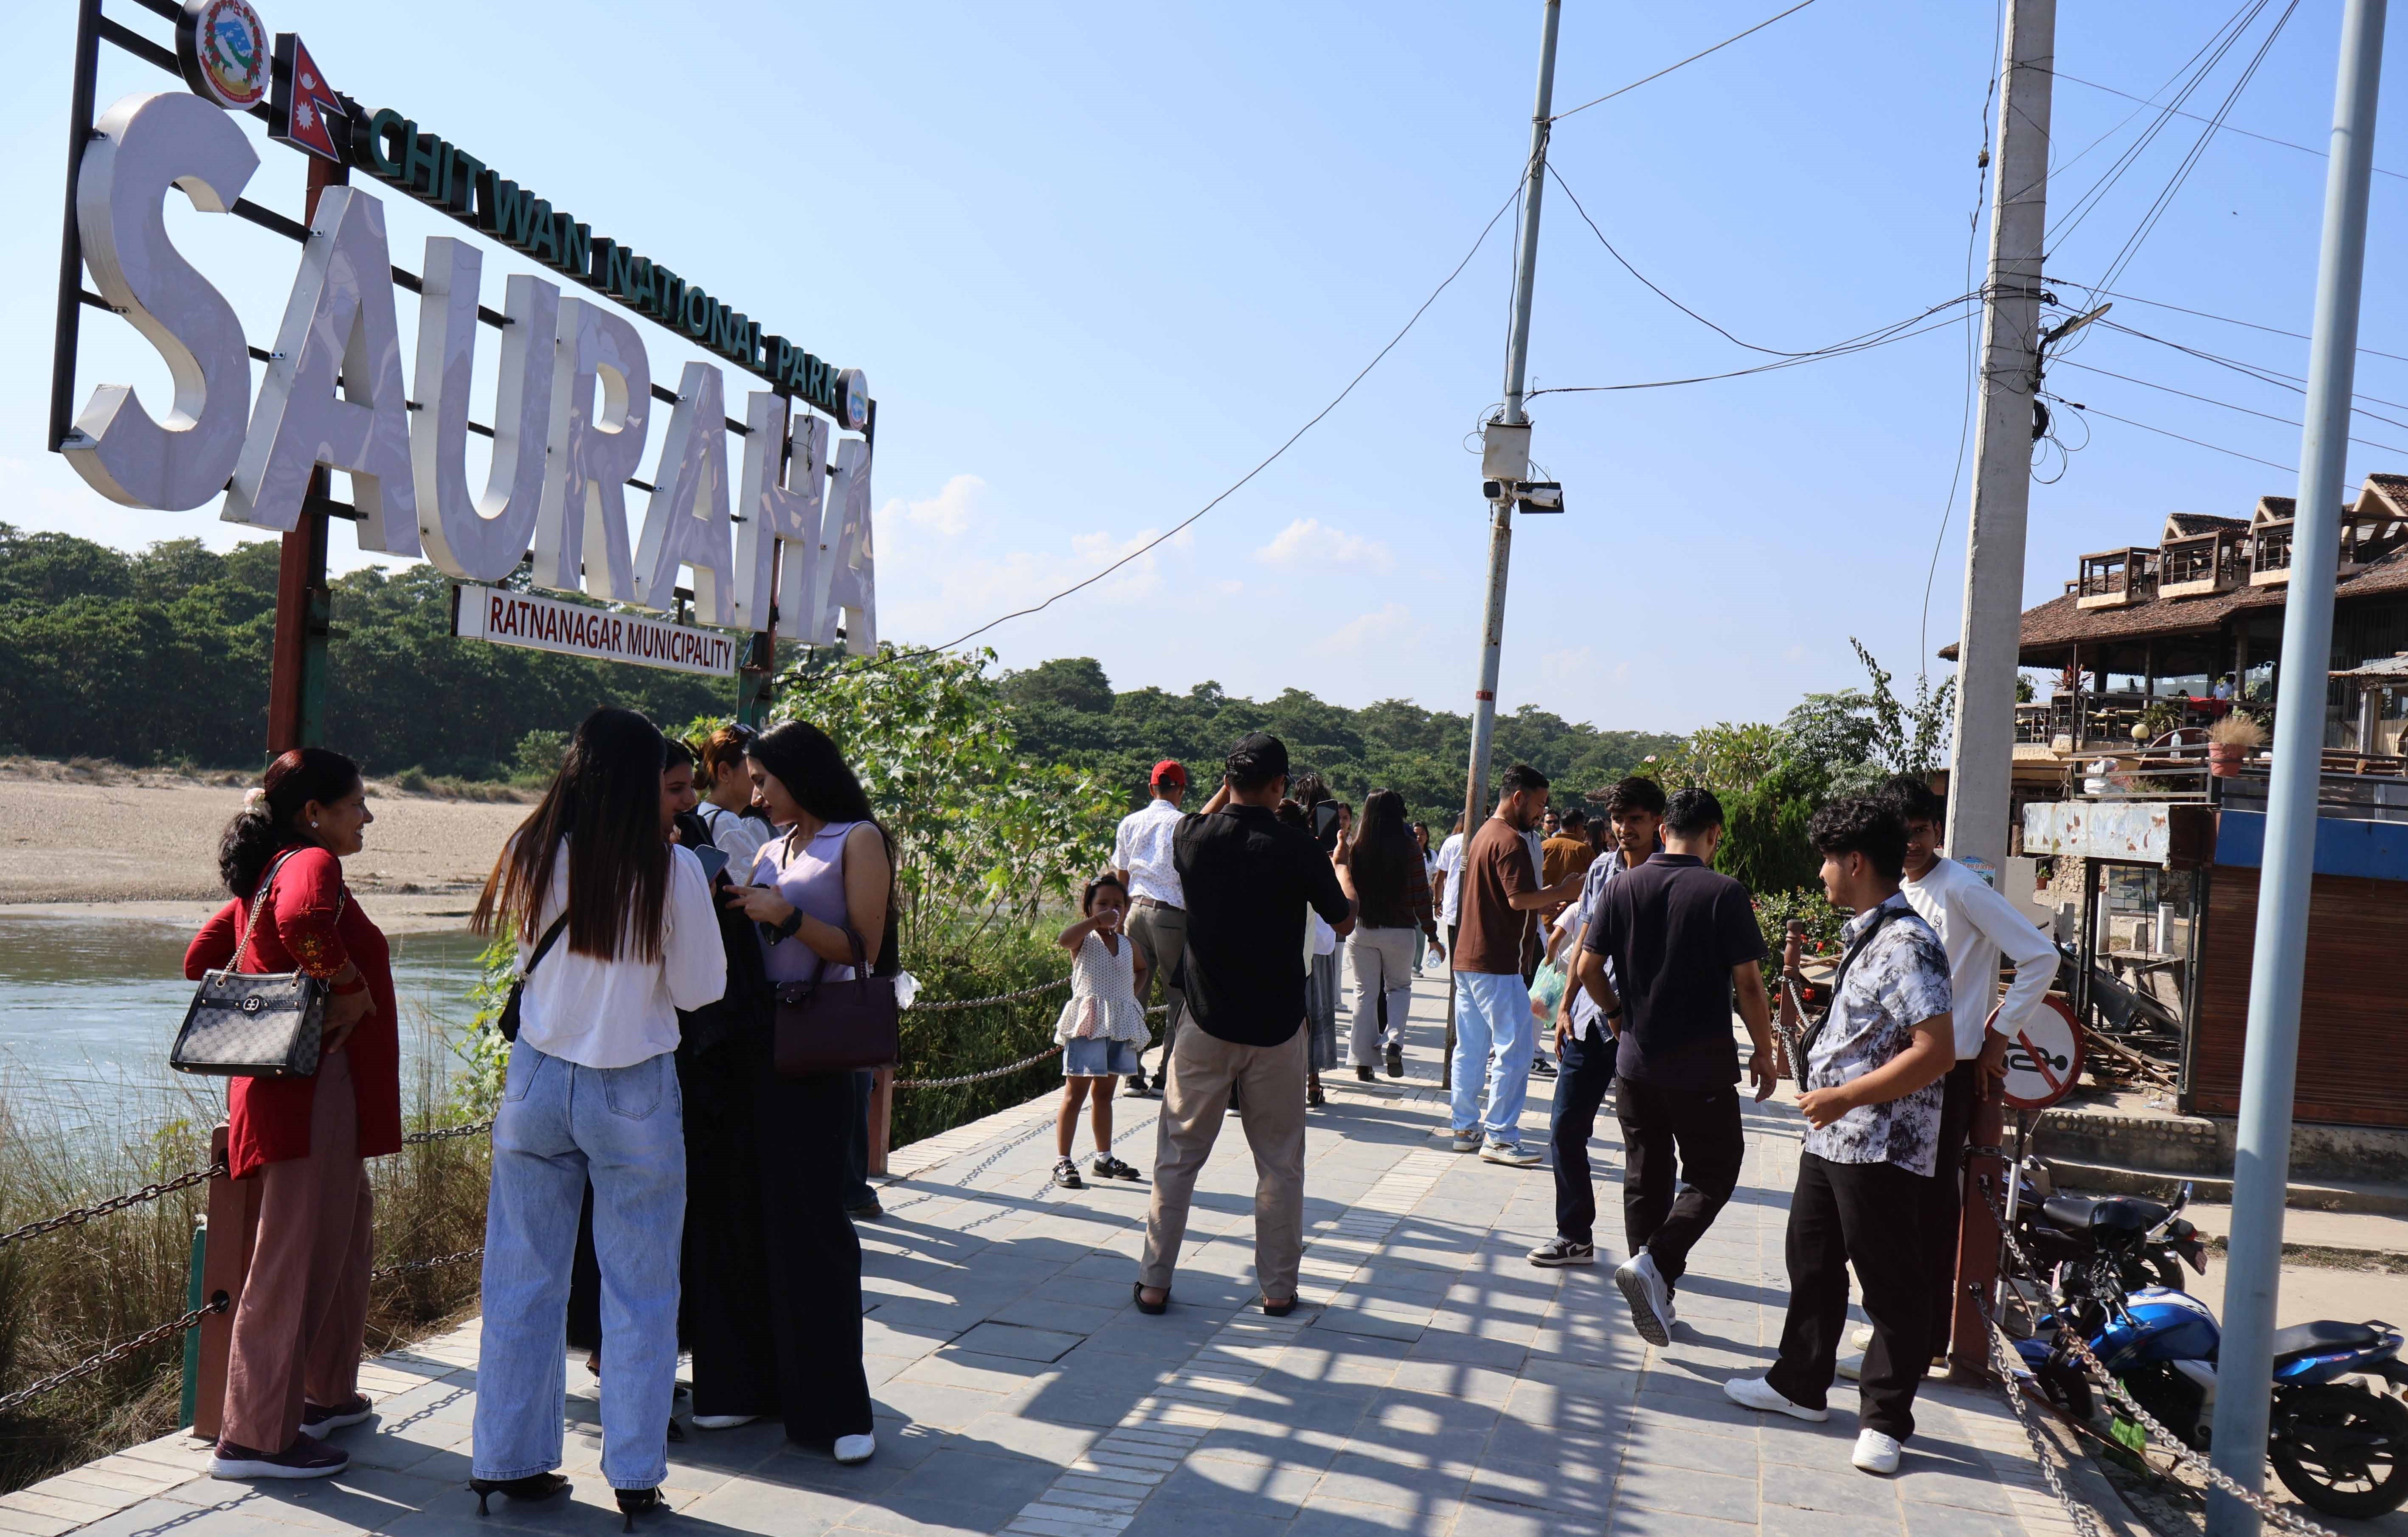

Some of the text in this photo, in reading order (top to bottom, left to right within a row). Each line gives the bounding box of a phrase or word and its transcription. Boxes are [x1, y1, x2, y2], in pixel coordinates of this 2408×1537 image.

[61, 92, 877, 657] SAURAHA
[606, 238, 767, 370] NATIONAL
[776, 335, 840, 409] PARK
[489, 596, 732, 671] RATNANAGAR MUNICIPALITY
